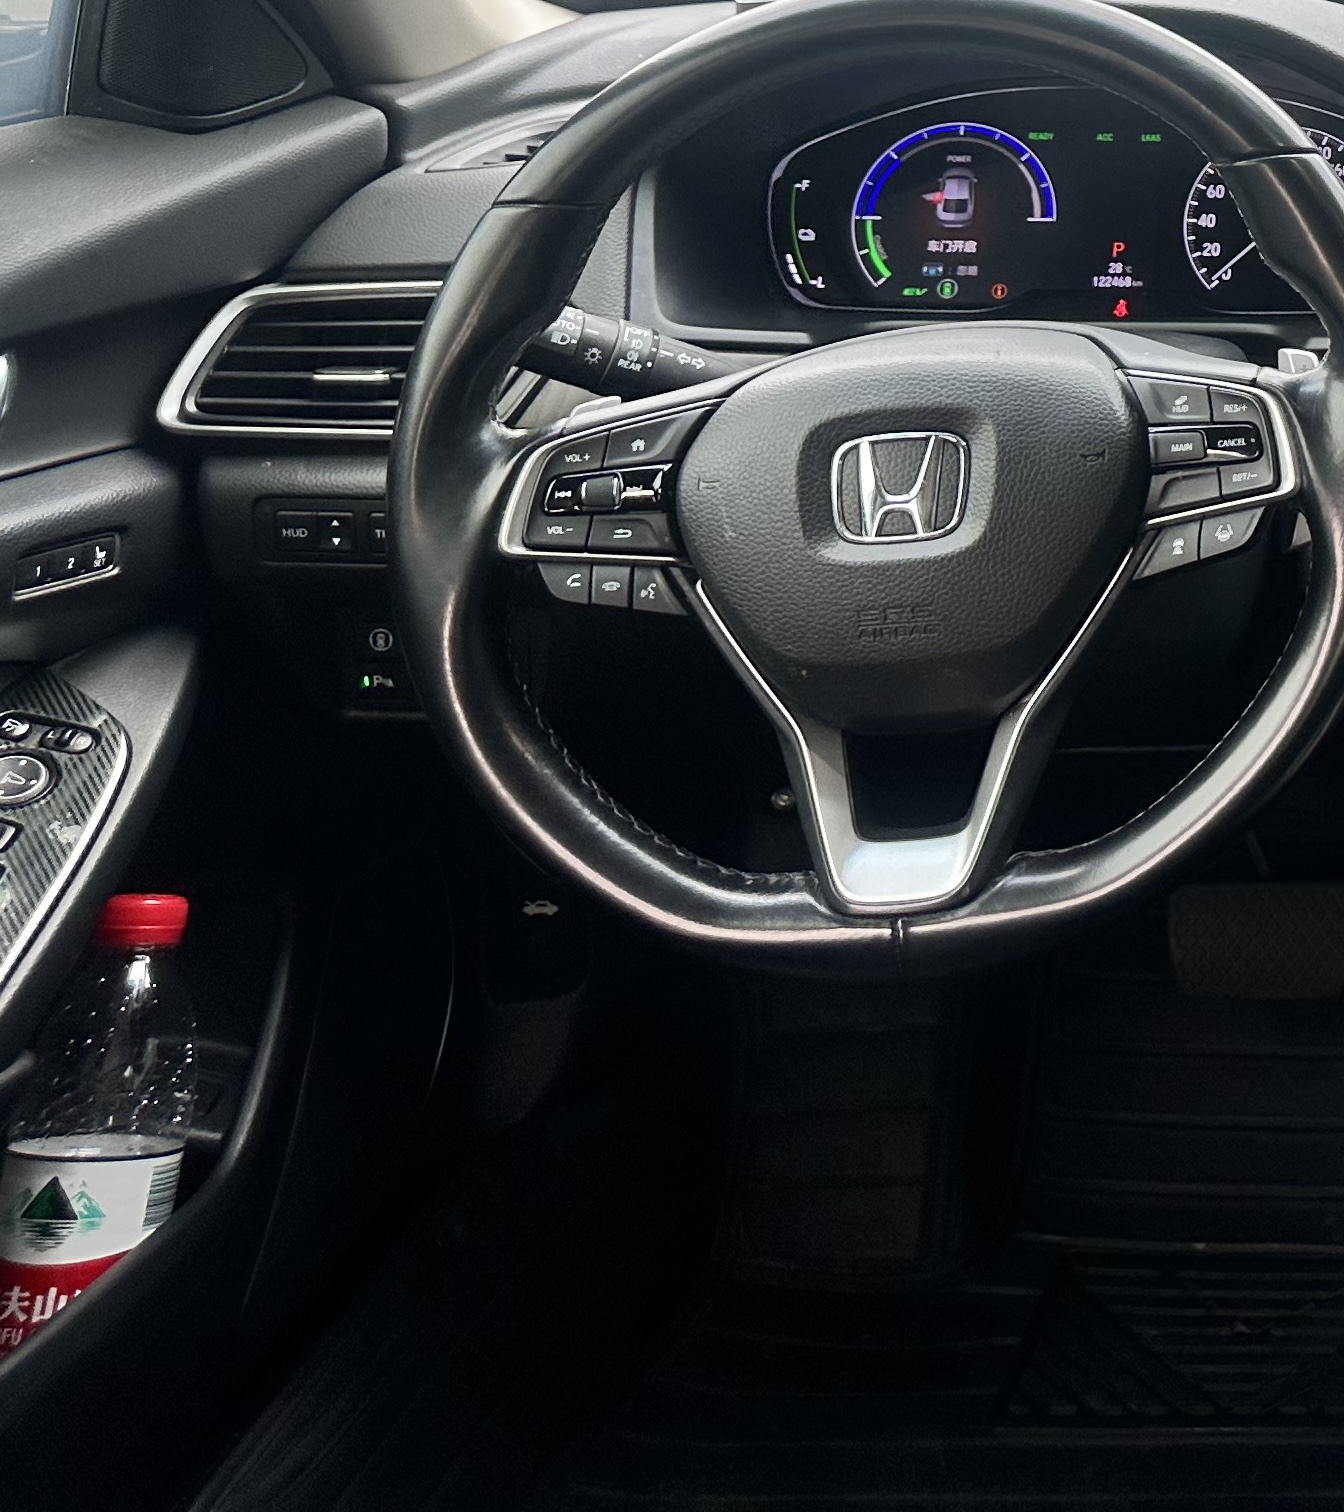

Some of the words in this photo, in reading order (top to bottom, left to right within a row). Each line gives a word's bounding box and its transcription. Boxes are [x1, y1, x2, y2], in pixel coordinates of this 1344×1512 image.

[946, 154, 972, 163] POWER
[1206, 184, 1226, 199] 60
[1198, 214, 1217, 228] 40
[1112, 241, 1126, 258] P
[1202, 242, 1221, 257] 20
[902, 287, 928, 296] EV
[617, 358, 643, 373] REAR
[1170, 442, 1193, 452] MAIN
[1217, 438, 1247, 448] CANCEL
[282, 528, 308, 538] HUD
